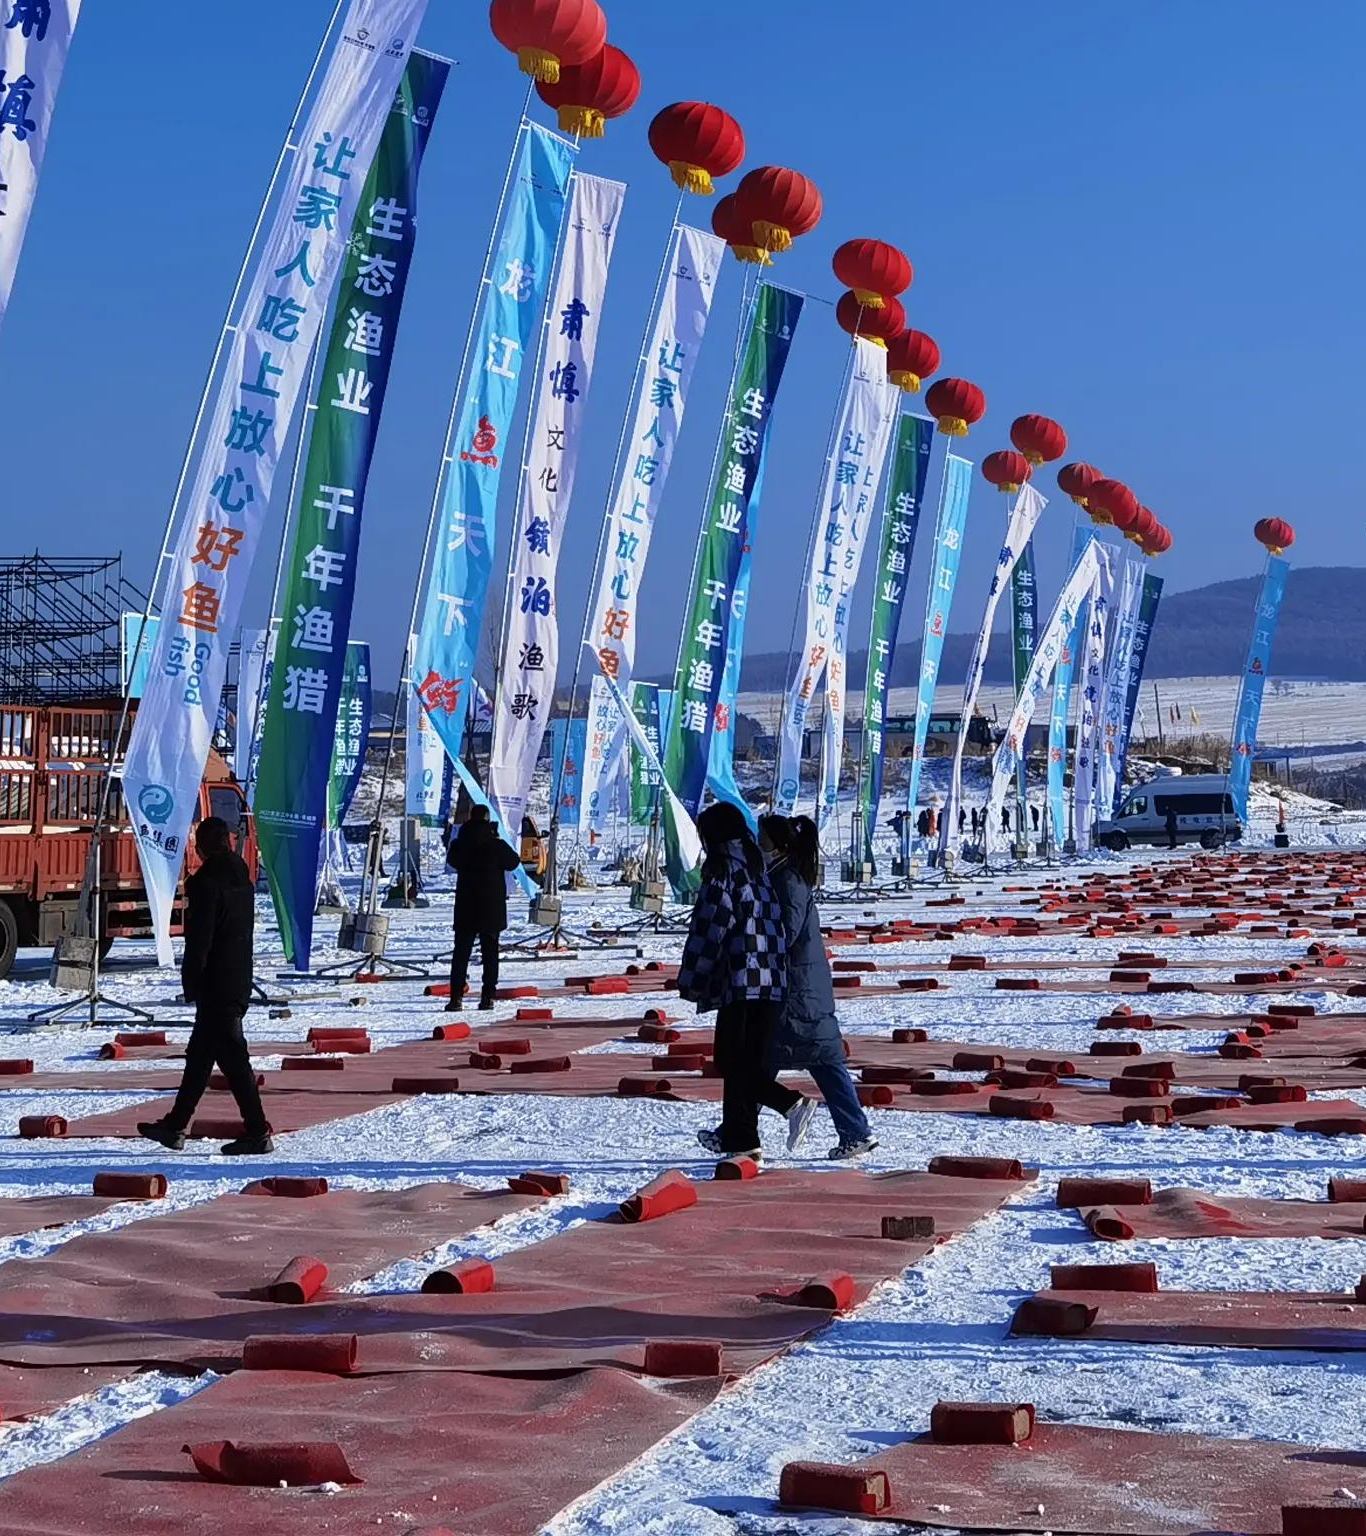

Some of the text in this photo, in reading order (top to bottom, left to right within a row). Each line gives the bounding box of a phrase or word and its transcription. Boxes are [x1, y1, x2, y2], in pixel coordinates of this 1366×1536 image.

[176, 131, 357, 633] 让家人吃上放心好鱼
[282, 196, 408, 715] 生态渔业 千年渔猎
[510, 297, 590, 721] 肃慎文化镜泊渔歌
[714, 387, 765, 534] 生态渔业
[165, 635, 187, 678] fish
[182, 641, 212, 707] Good
[681, 578, 727, 735] 千年渔猎
[1016, 569, 1034, 652] 生态渔业
